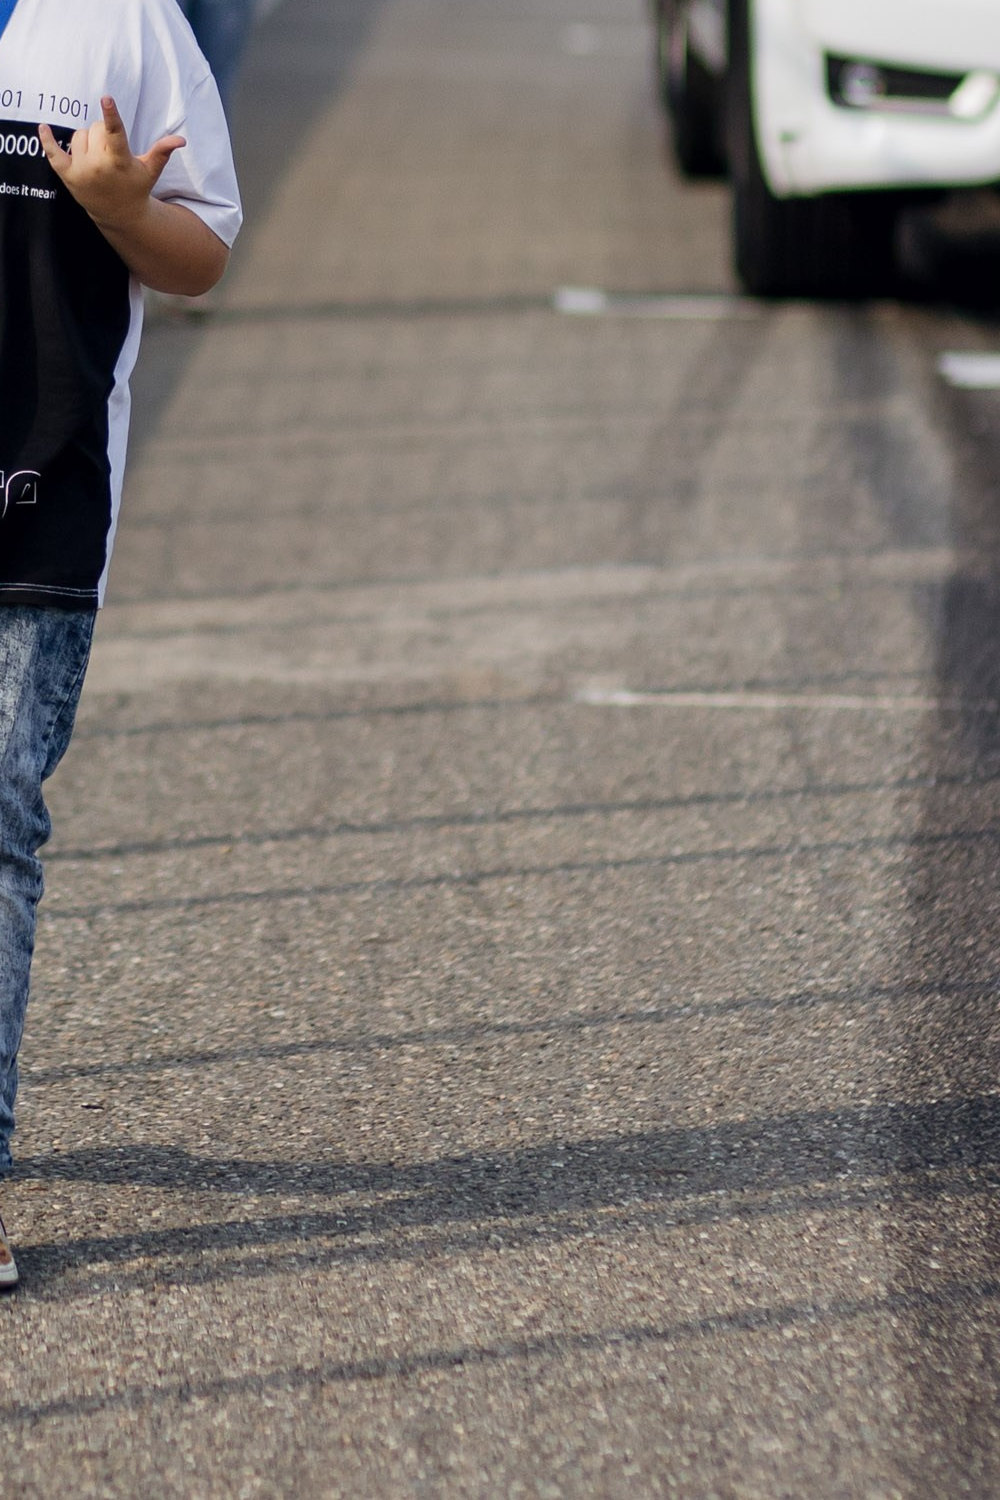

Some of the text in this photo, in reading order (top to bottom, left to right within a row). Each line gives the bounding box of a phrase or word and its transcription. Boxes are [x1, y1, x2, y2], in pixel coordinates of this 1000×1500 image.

[38, 93, 89, 122] 11001
[0, 183, 20, 196] does
[21, 184, 29, 197] it
